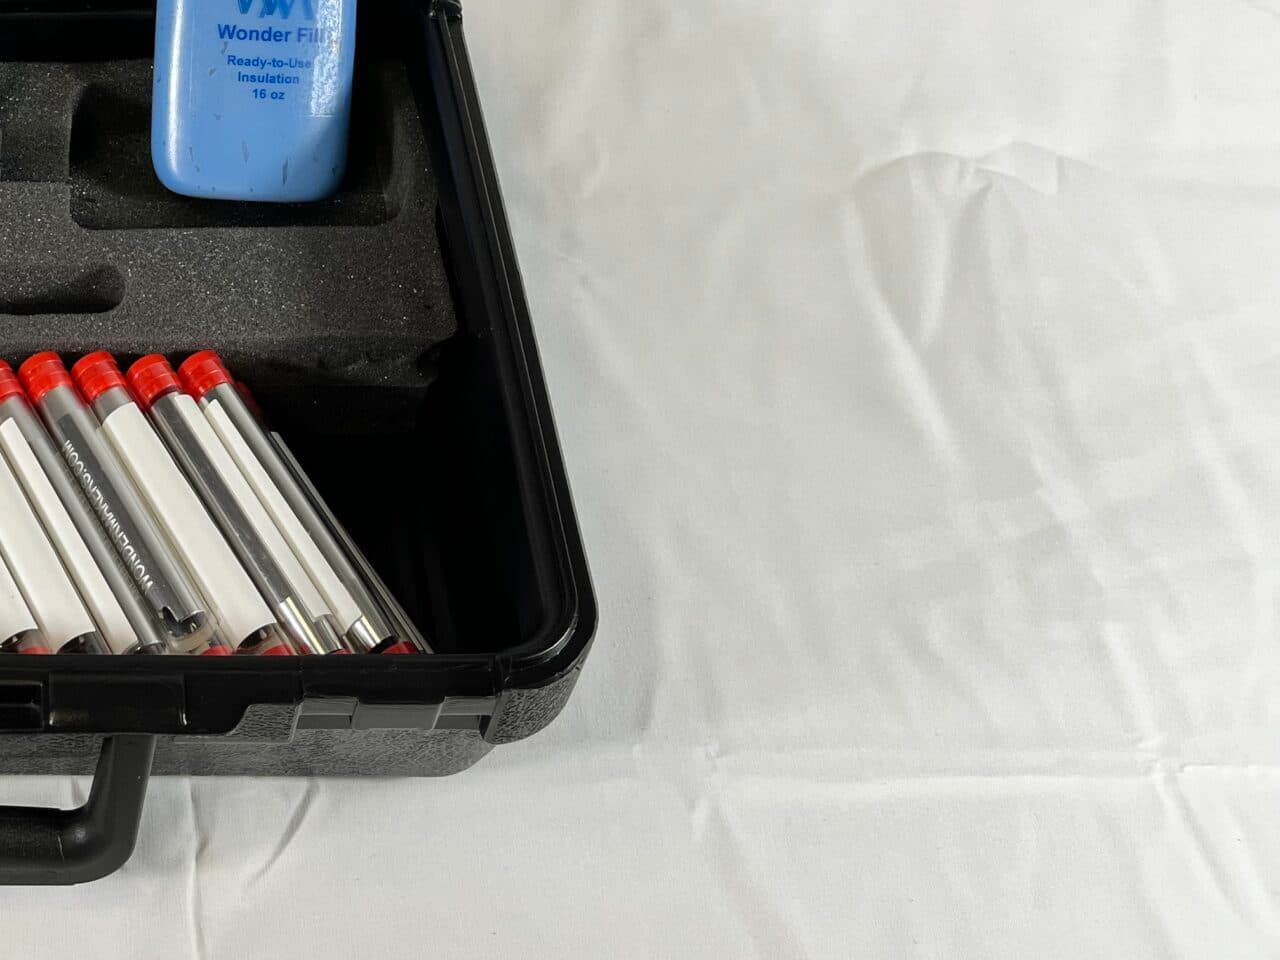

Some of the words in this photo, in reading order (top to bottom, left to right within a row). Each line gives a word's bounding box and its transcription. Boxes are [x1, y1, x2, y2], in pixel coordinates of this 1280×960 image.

[217, 23, 290, 42] Wonder
[227, 55, 311, 70] Ready-to-Use
[238, 72, 299, 84] Insulation
[253, 89, 266, 99] 16
[270, 91, 285, 100] oz
